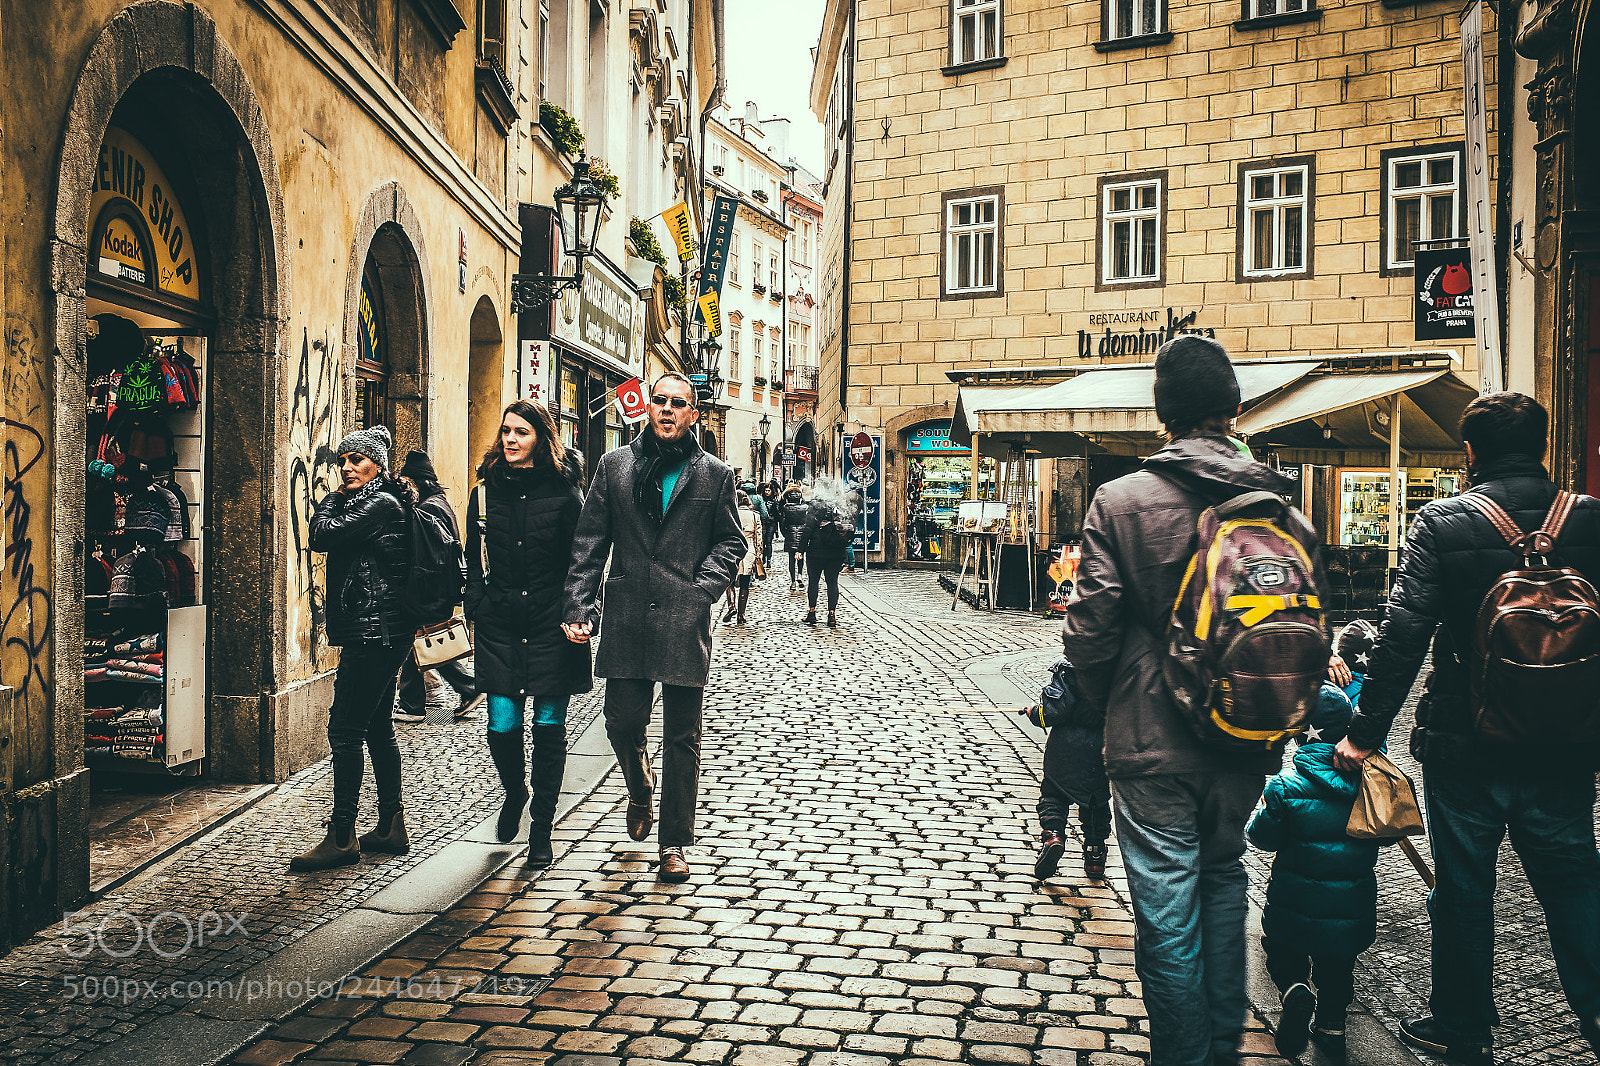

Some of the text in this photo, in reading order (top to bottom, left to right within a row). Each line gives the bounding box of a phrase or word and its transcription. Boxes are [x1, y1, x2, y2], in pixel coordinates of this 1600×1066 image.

[103, 229, 141, 261] Kodak
[149, 184, 192, 285] SHOP
[705, 201, 731, 293] RESTAURA
[359, 286, 378, 358] RISTAL
[1089, 311, 1160, 325] RESTAURANT
[1446, 319, 1467, 327] PRAHA
[528, 344, 541, 399] MINI MA
[917, 429, 950, 437] SOUV
[931, 440, 961, 448] WOR
